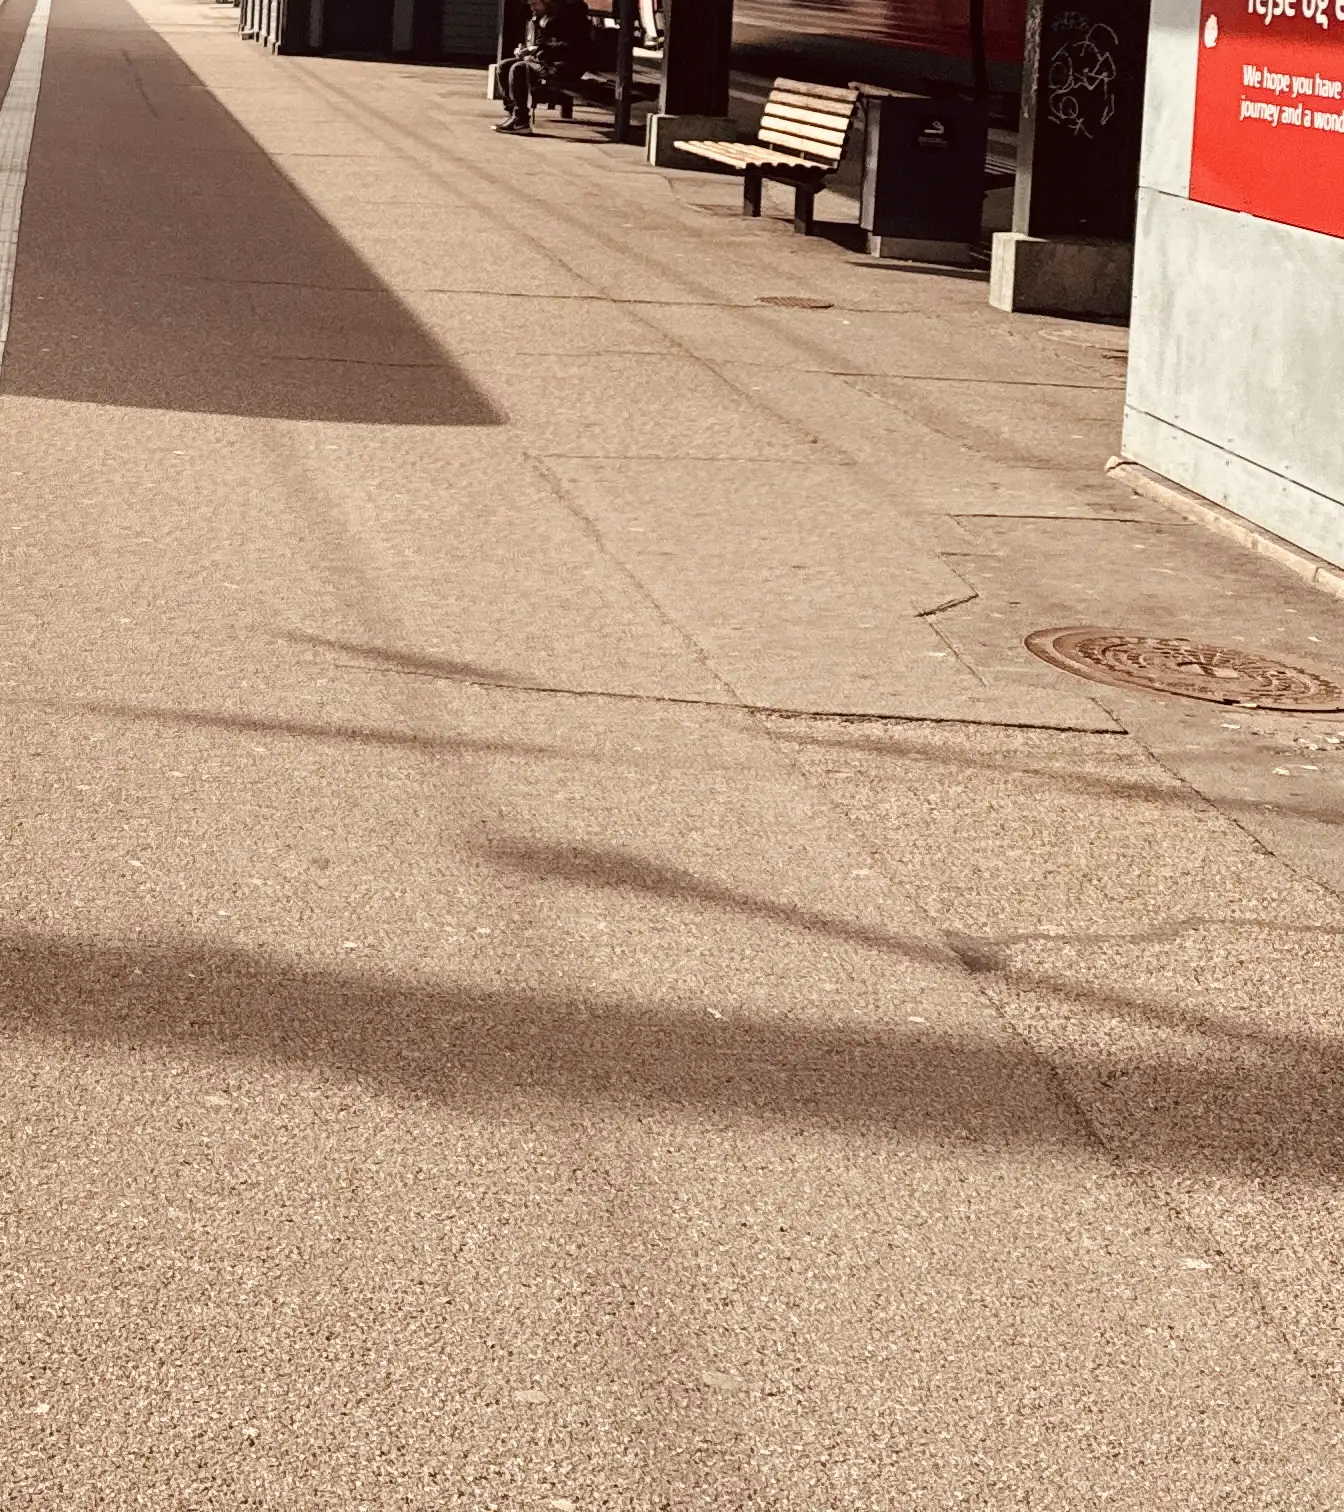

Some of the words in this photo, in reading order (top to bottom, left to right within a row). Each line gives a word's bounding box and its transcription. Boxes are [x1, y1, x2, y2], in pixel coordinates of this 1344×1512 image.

[1242, 64, 1261, 88] We
[1263, 66, 1290, 96] hope
[1291, 75, 1313, 98] you
[1315, 72, 1342, 99] have
[1239, 94, 1280, 127] journey
[1281, 103, 1303, 126] and
[1304, 109, 1312, 128] a
